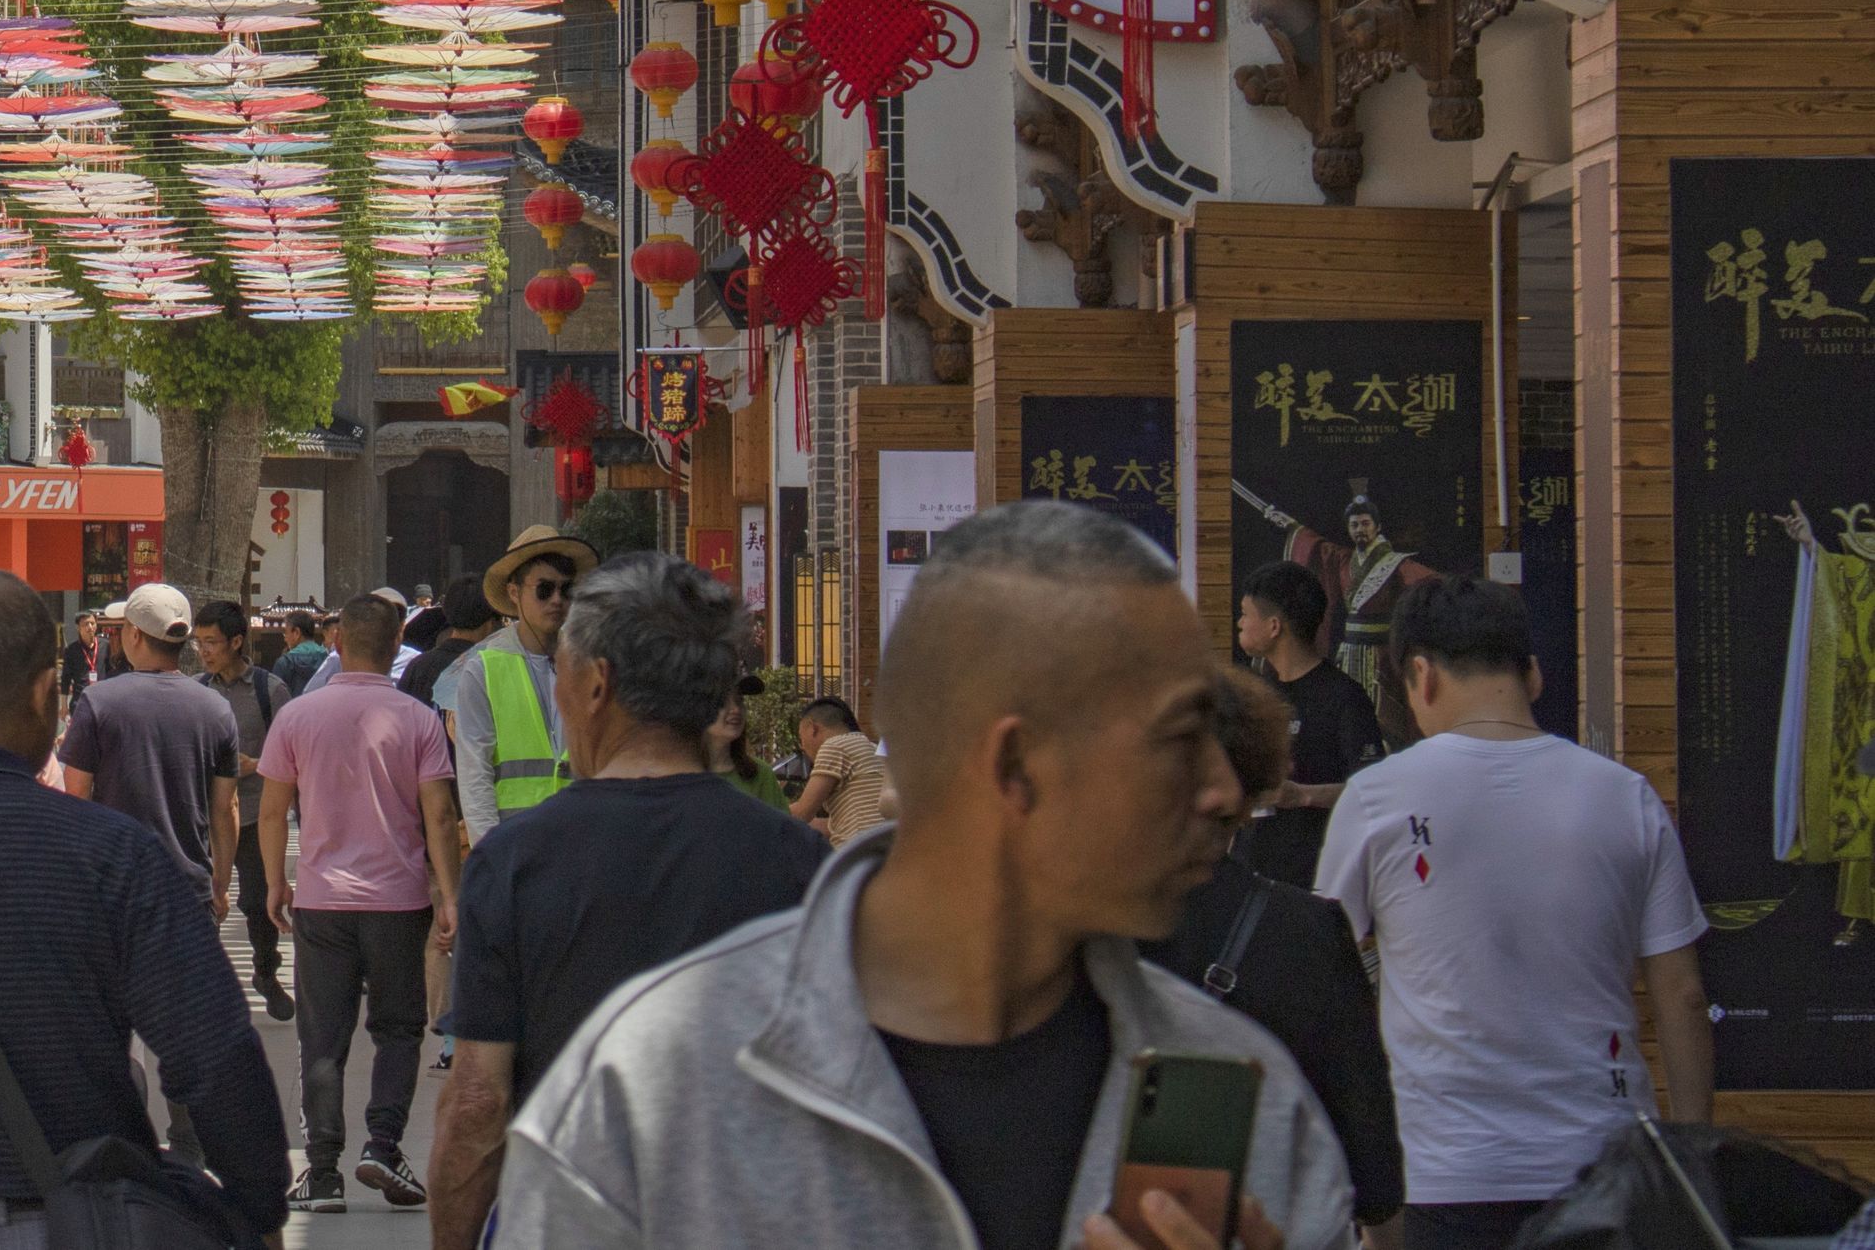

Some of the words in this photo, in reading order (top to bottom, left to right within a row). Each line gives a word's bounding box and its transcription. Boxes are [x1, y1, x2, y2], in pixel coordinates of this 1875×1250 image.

[1704, 227, 1875, 364] 醉美
[660, 371, 687, 423] 烤猪蹄
[1254, 362, 1456, 448] 醉美太湖
[1519, 476, 1568, 526] 湖
